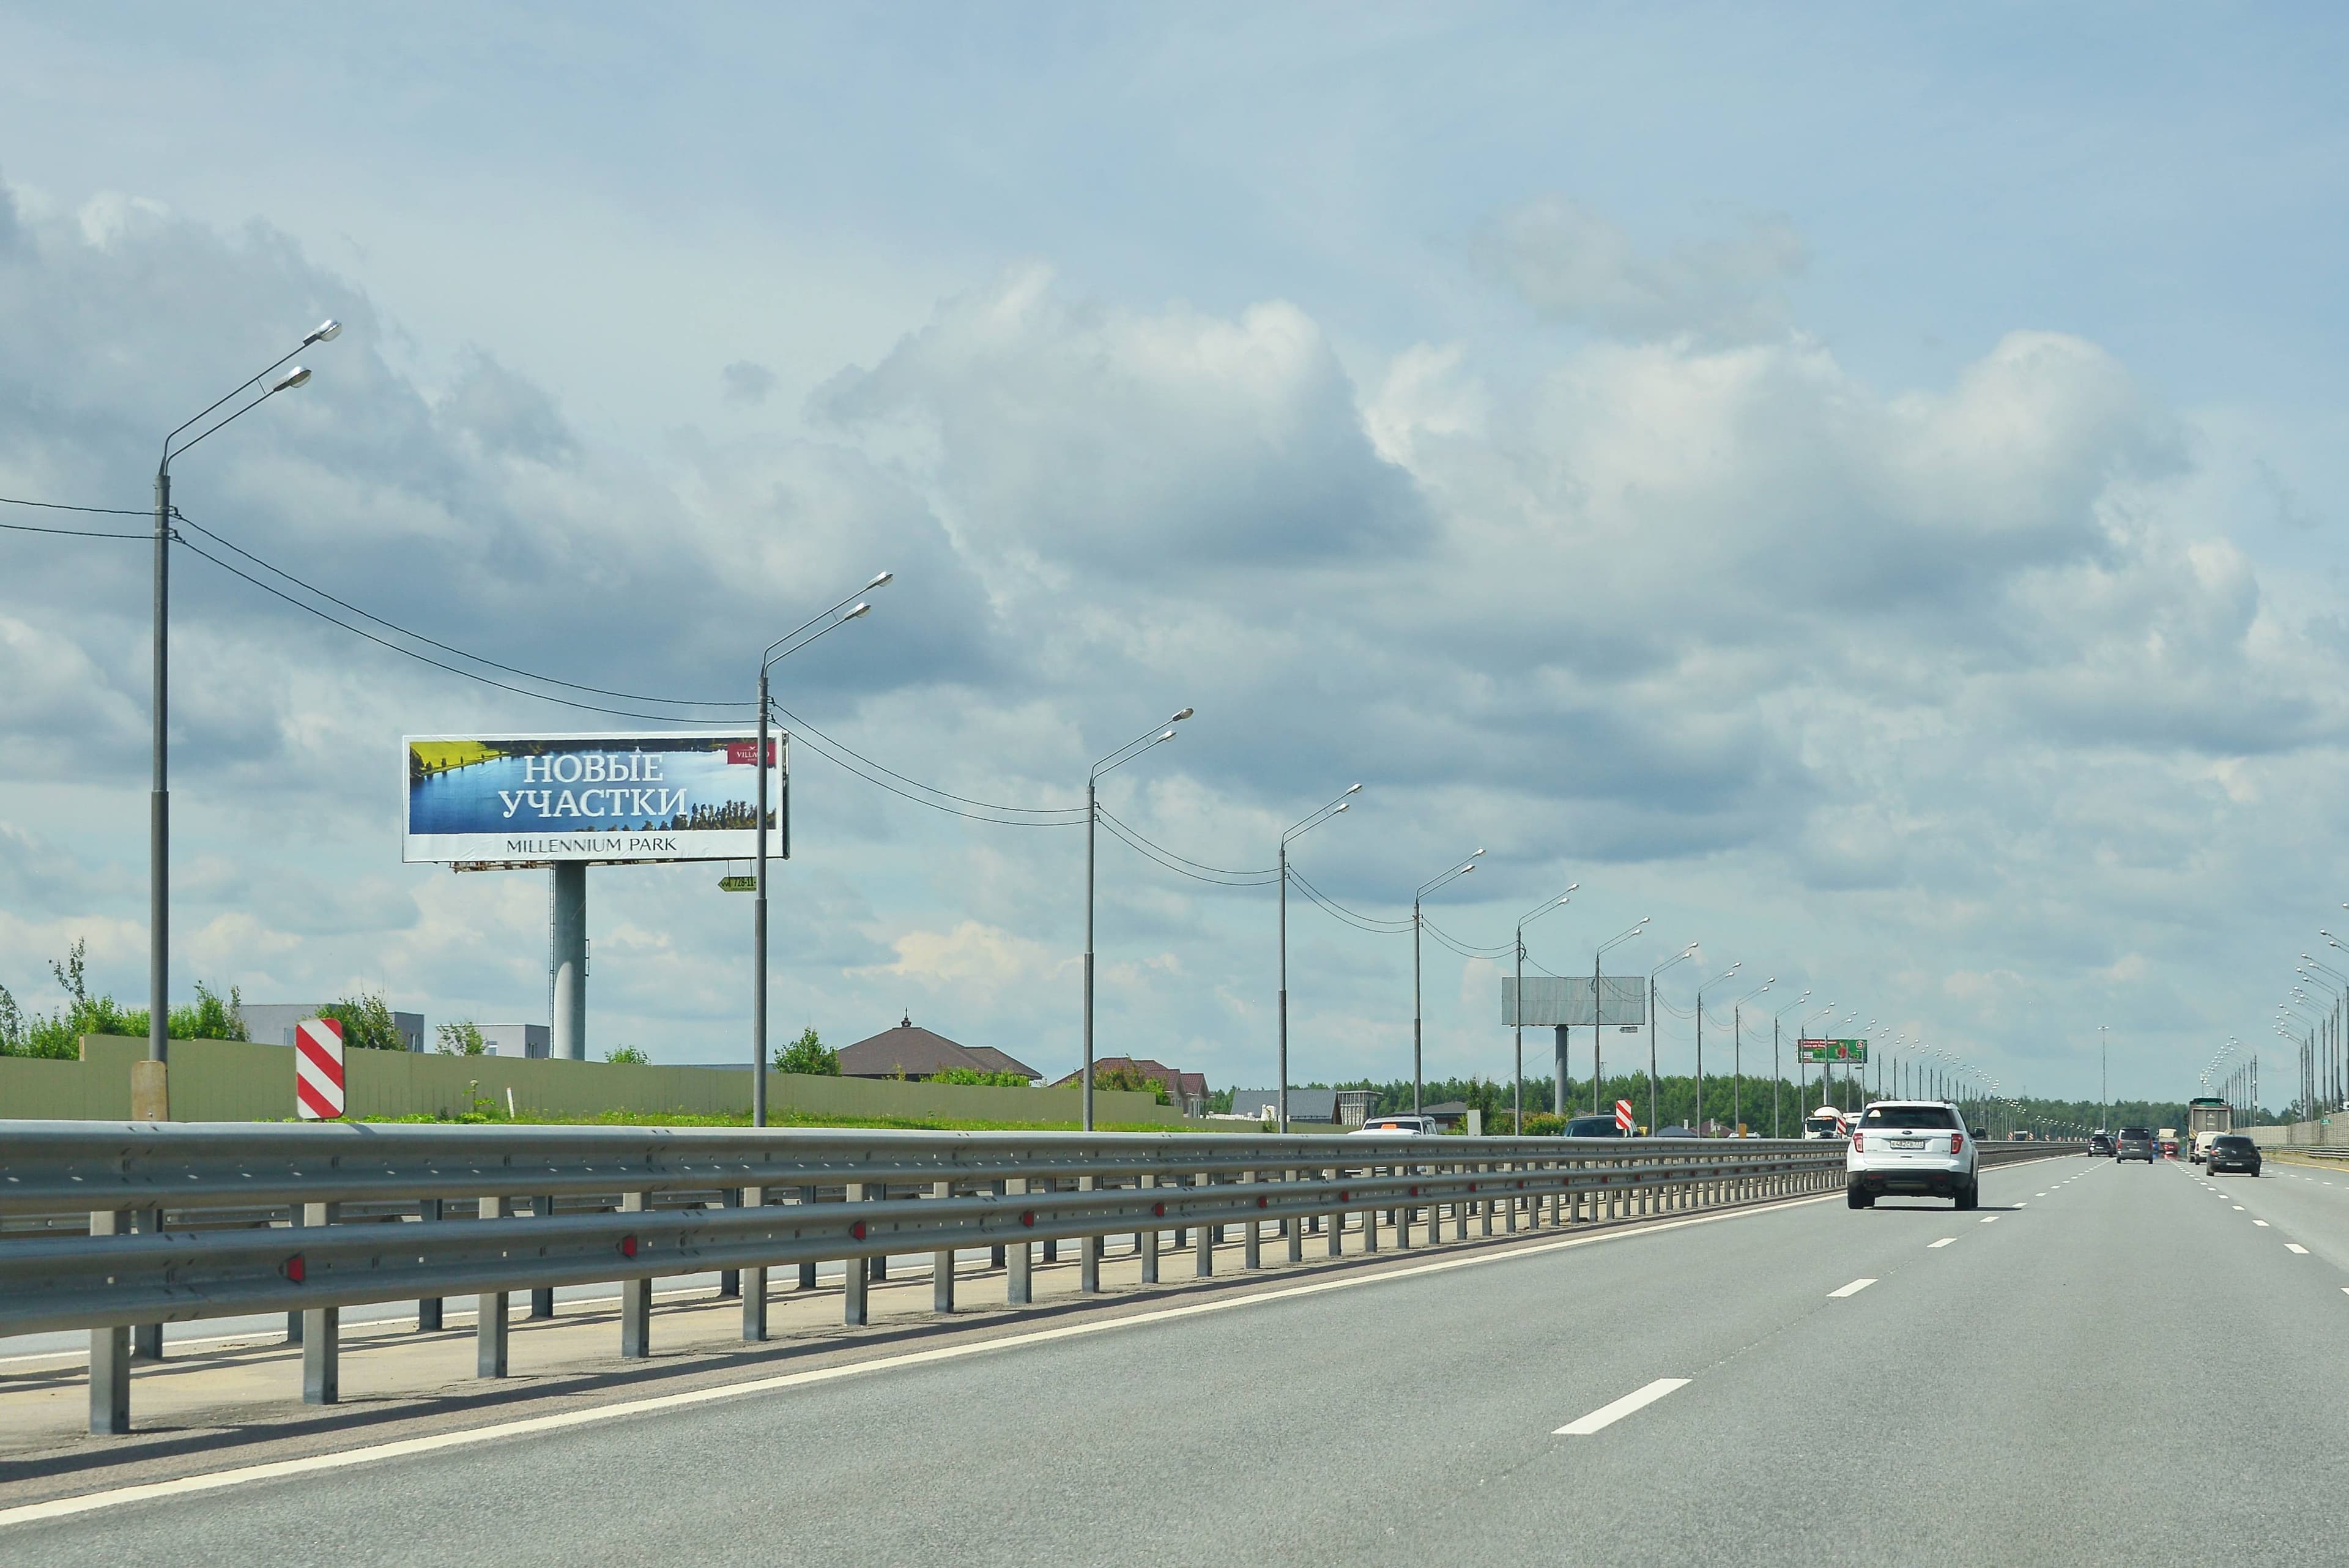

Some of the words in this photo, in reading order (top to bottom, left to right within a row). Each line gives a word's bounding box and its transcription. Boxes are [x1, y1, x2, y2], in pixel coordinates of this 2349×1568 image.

[524, 754, 663, 782] НОВЫЕ
[498, 789, 688, 818] УЧАСТКИ
[507, 838, 621, 853] MILLENNIUM
[629, 837, 678, 851] PARK
